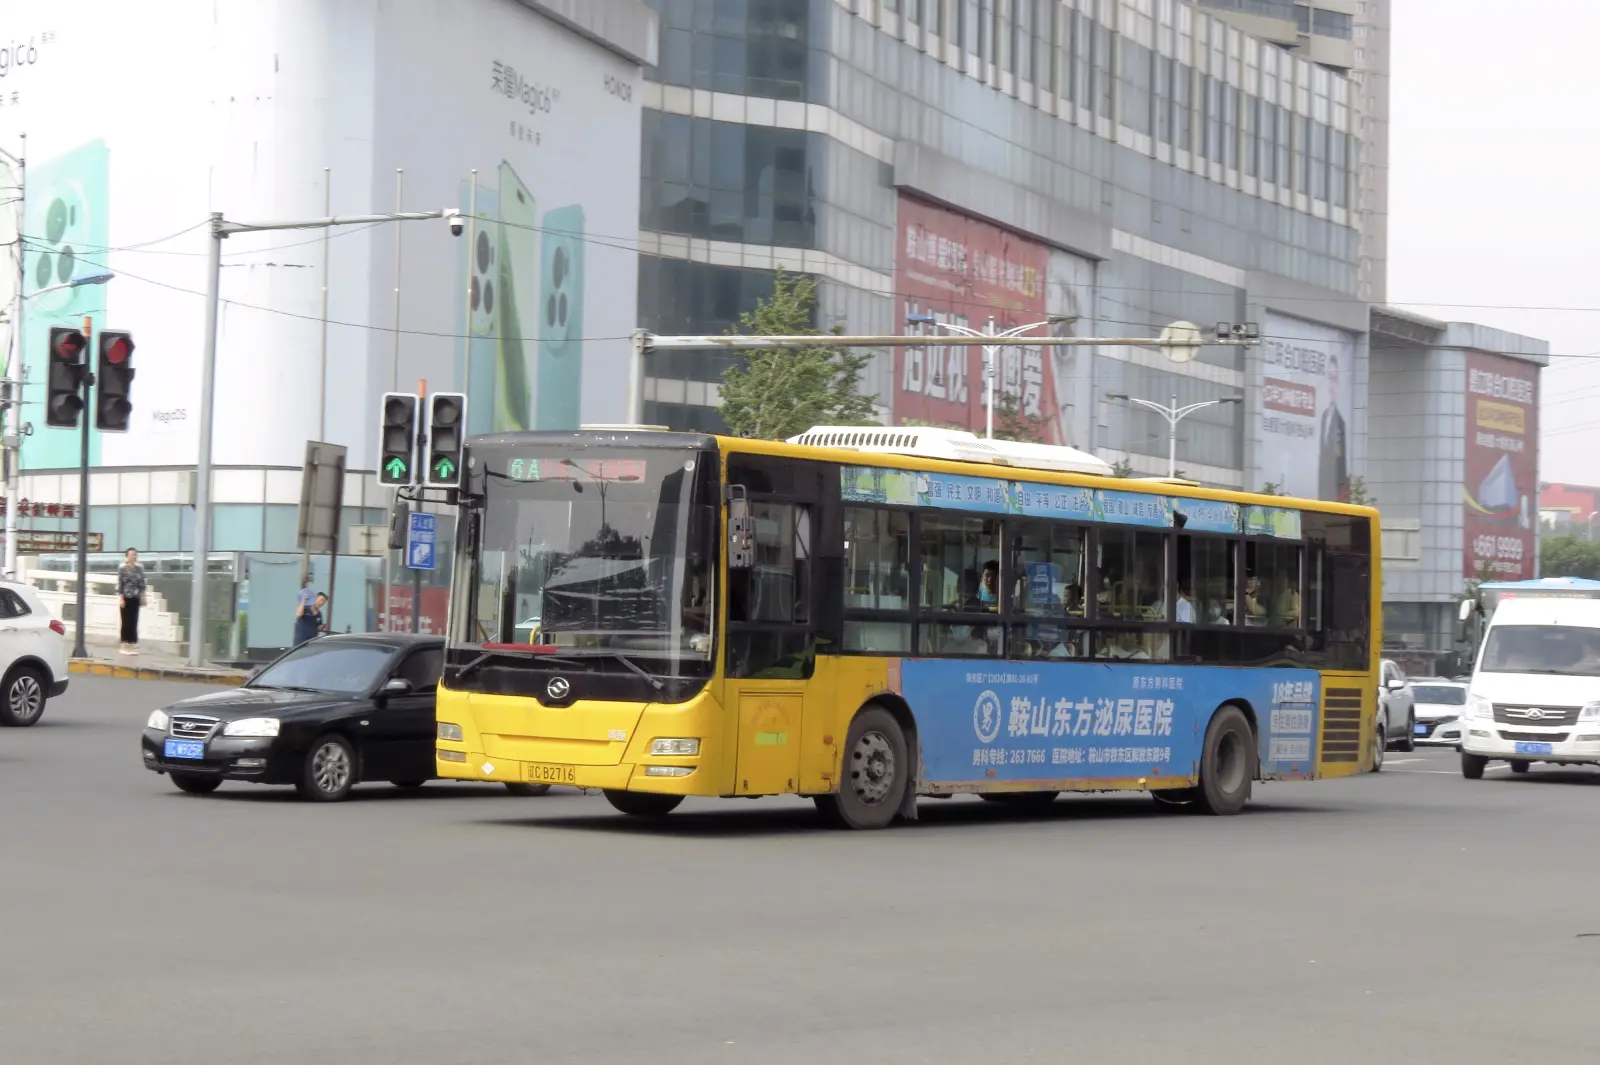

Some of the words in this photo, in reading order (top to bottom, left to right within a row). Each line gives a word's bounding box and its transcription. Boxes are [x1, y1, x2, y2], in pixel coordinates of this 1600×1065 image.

[511, 458, 540, 481] 6A
[927, 481, 942, 499] 富强
[947, 483, 962, 500] 民主
[967, 485, 982, 501] 文明
[1017, 491, 1032, 507] 自由
[1035, 492, 1050, 509] 平等
[1054, 494, 1068, 510] 公正
[1007, 696, 1175, 738] 鞍山东方泌尿医院
[1026, 749, 1047, 764] 7666
